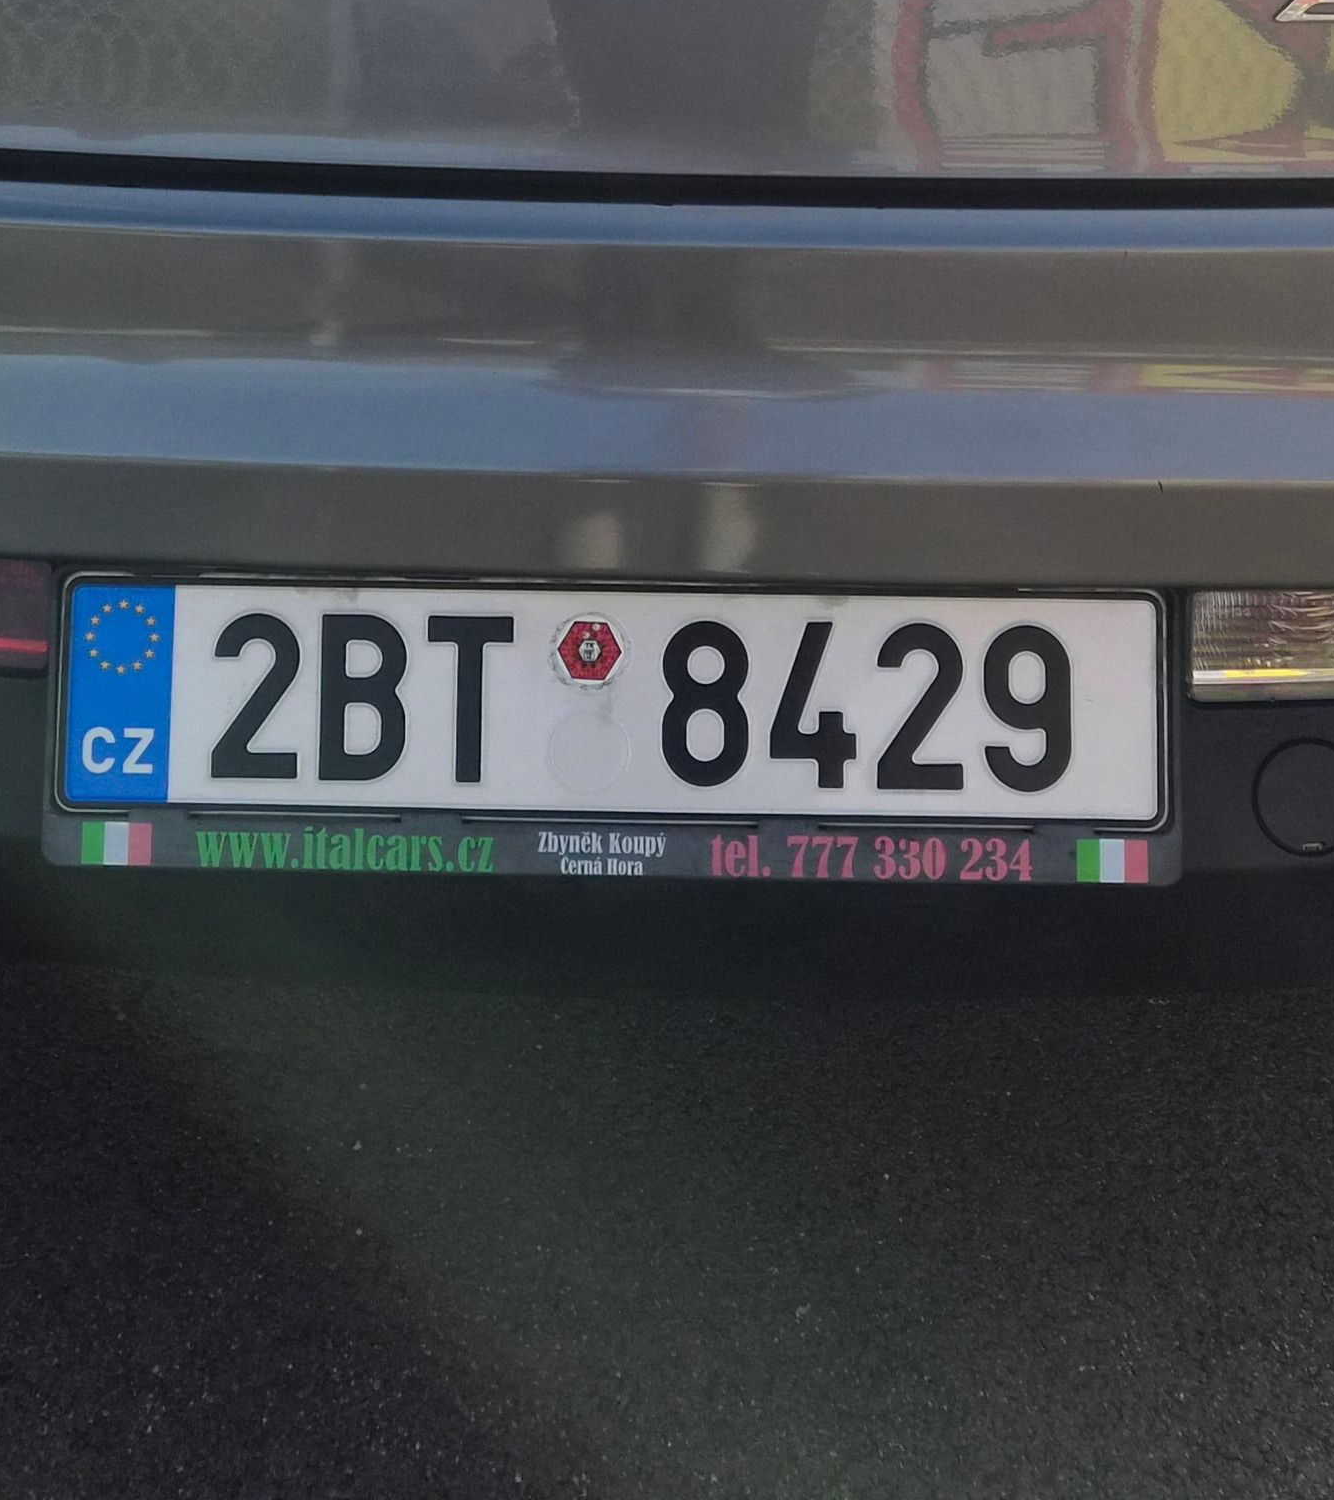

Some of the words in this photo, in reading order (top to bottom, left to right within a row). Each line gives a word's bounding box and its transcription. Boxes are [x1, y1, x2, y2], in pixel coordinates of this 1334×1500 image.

[210, 612, 515, 783] 2BT
[661, 619, 1072, 794] 8429
[82, 726, 155, 775] CZ
[196, 826, 495, 873] www.italcars.cz
[538, 831, 603, 855] Zbyněk
[608, 832, 667, 858] Koupý
[606, 857, 644, 877] Hora
[710, 833, 771, 878] tel.
[786, 835, 858, 879] 777
[873, 836, 946, 880] 330
[959, 838, 1033, 882] 234
